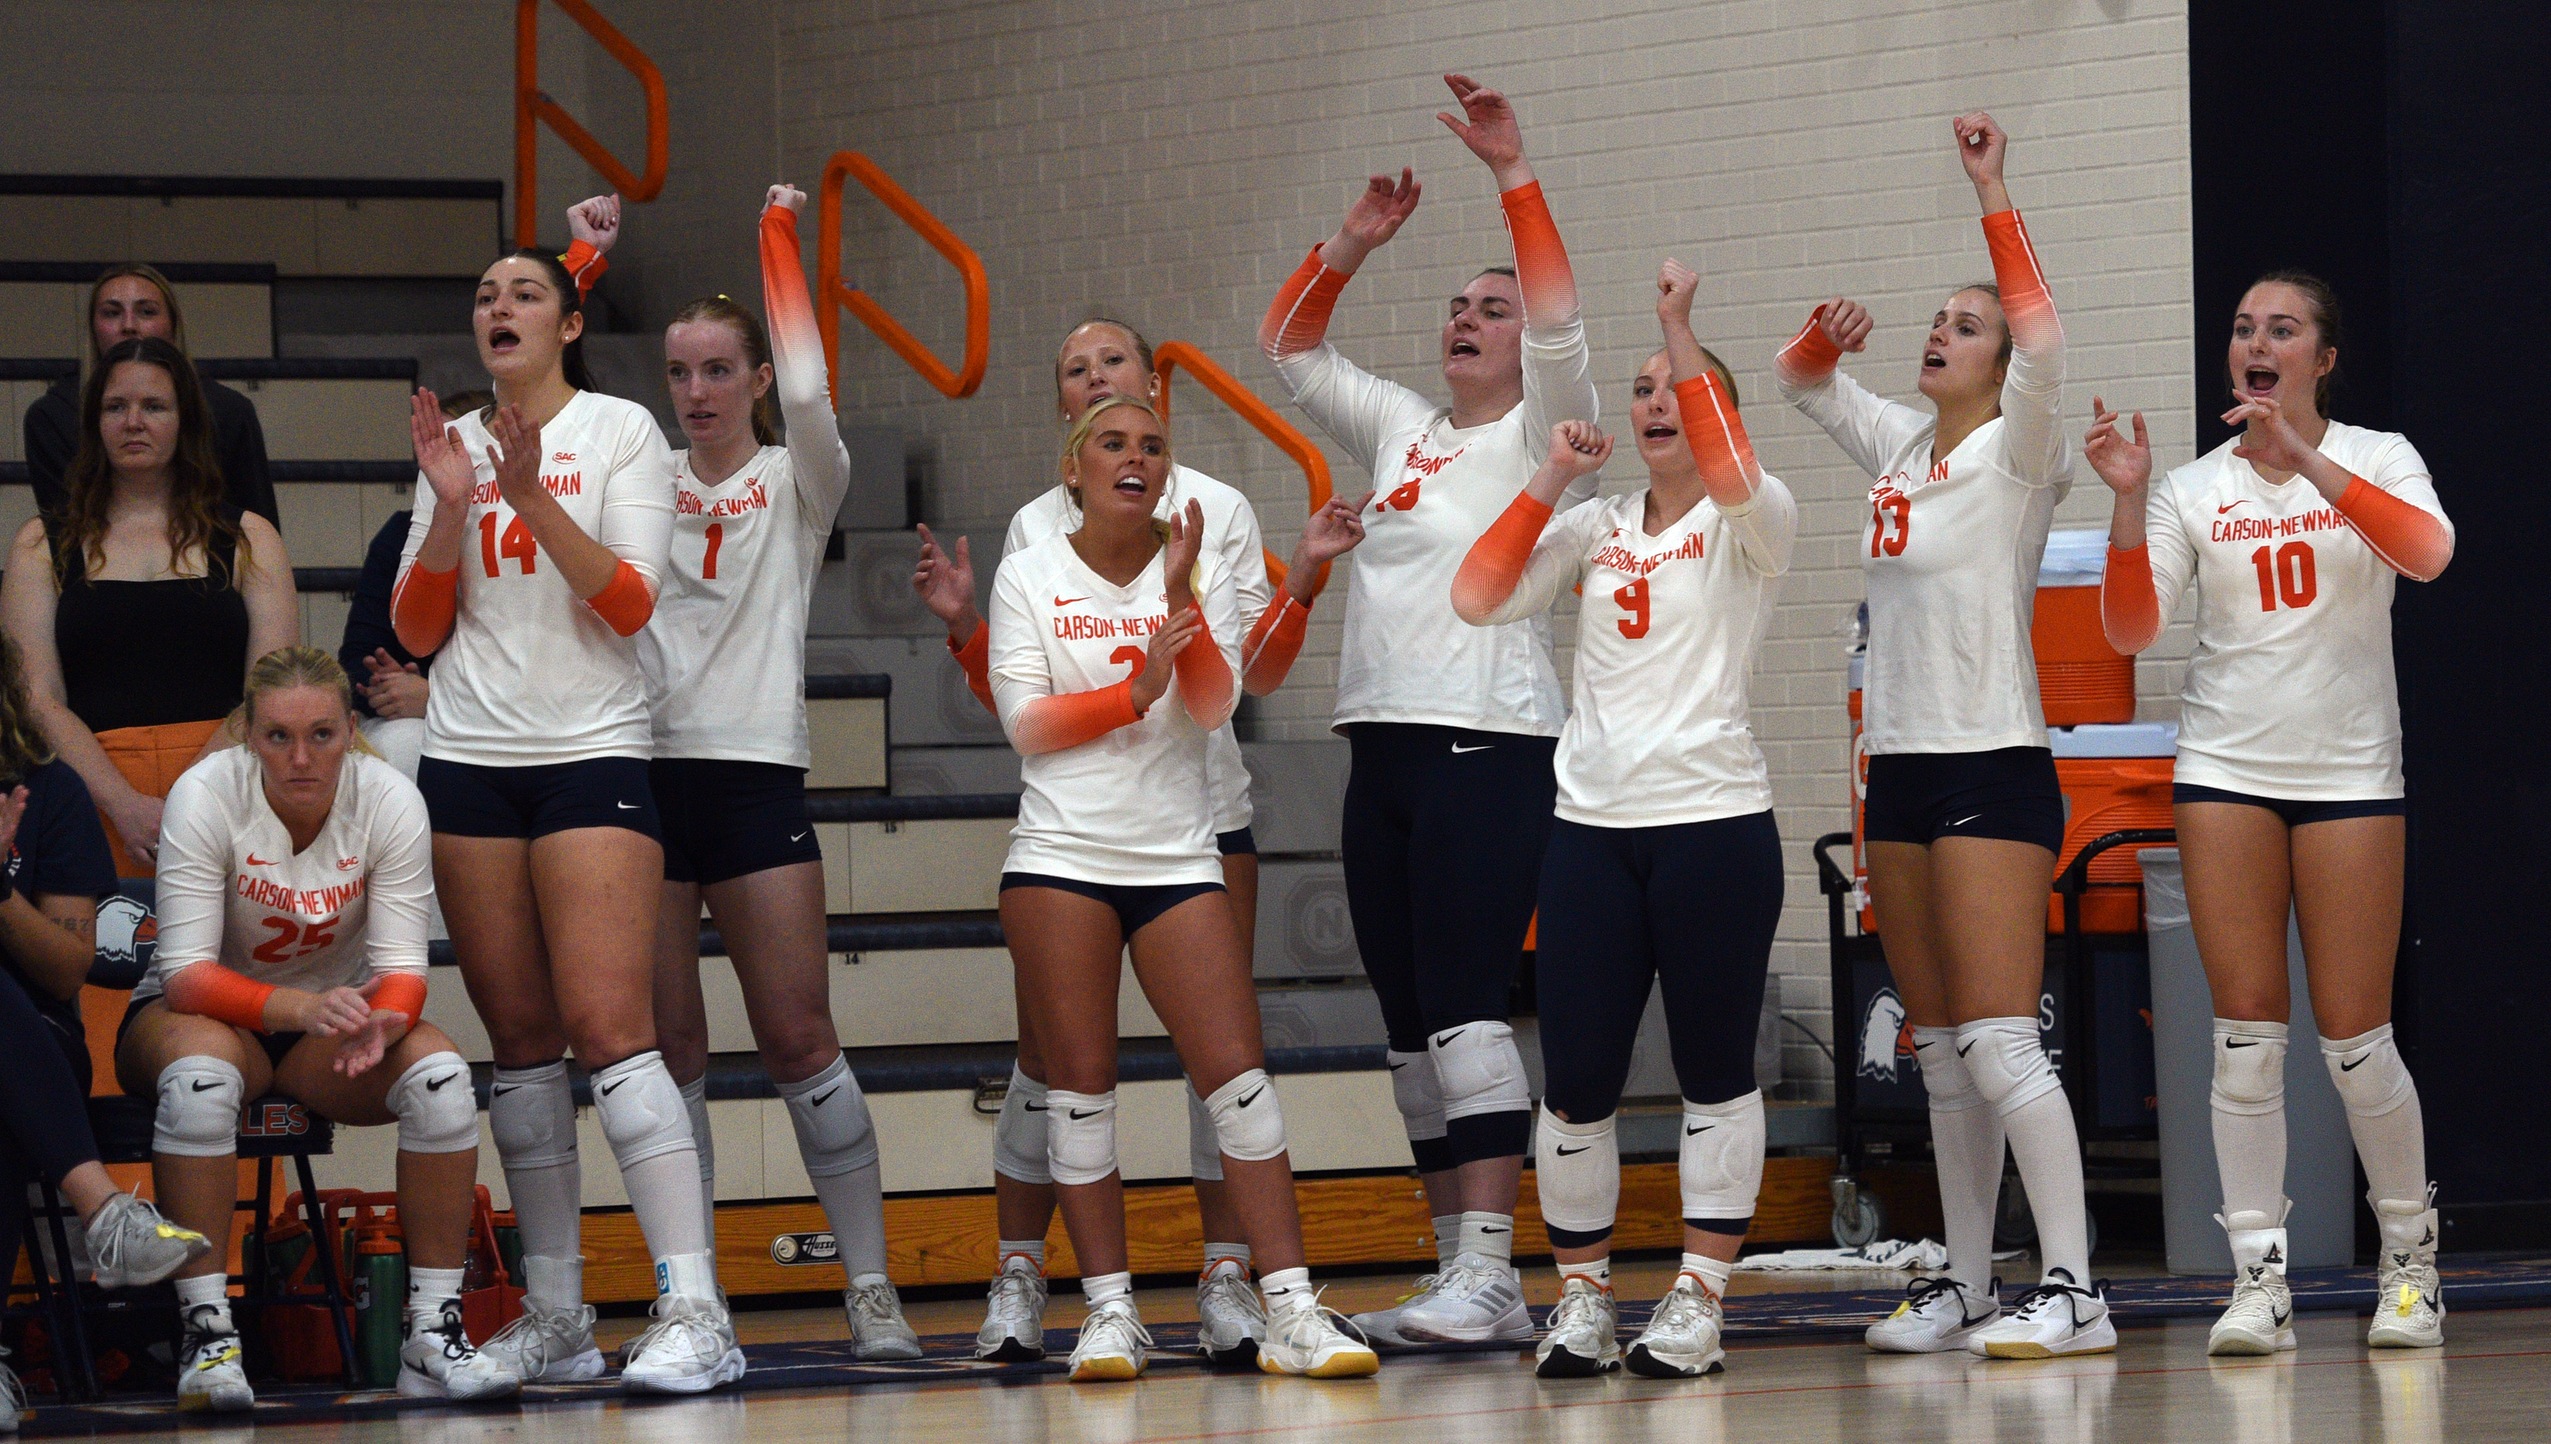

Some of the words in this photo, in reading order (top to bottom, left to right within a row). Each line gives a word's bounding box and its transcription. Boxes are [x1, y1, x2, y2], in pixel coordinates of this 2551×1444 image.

[554, 451, 577, 461] SAC
[478, 511, 537, 578] 14
[1872, 494, 1911, 558] 13
[2211, 509, 2347, 543] CARSON-NEWMA
[702, 523, 724, 580] 1
[2251, 540, 2318, 612] 10
[1053, 614, 1168, 641] CARSON-NEW
[1613, 577, 1650, 639] 9
[252, 915, 341, 963] 25
[240, 1103, 310, 1137] LES
[802, 1236, 836, 1255] HUSSE
